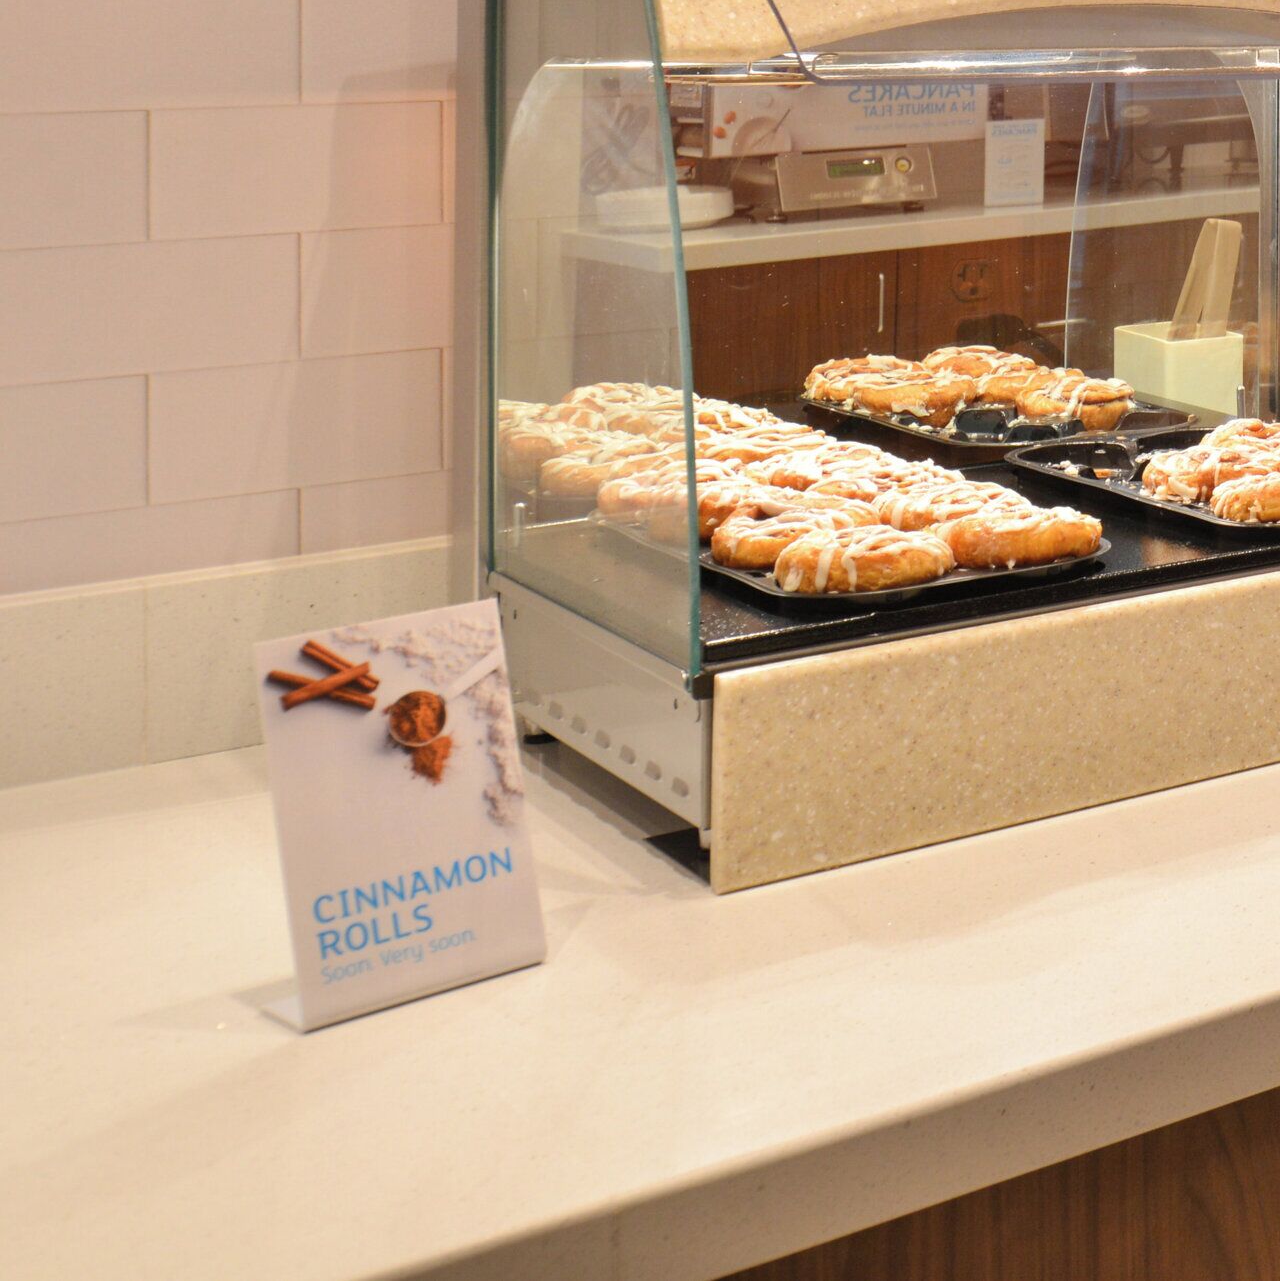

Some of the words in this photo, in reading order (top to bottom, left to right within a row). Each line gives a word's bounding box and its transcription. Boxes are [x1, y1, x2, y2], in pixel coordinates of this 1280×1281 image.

[313, 847, 513, 924] CINNAMON
[316, 903, 433, 960] ROLLS
[379, 942, 424, 966] Very
